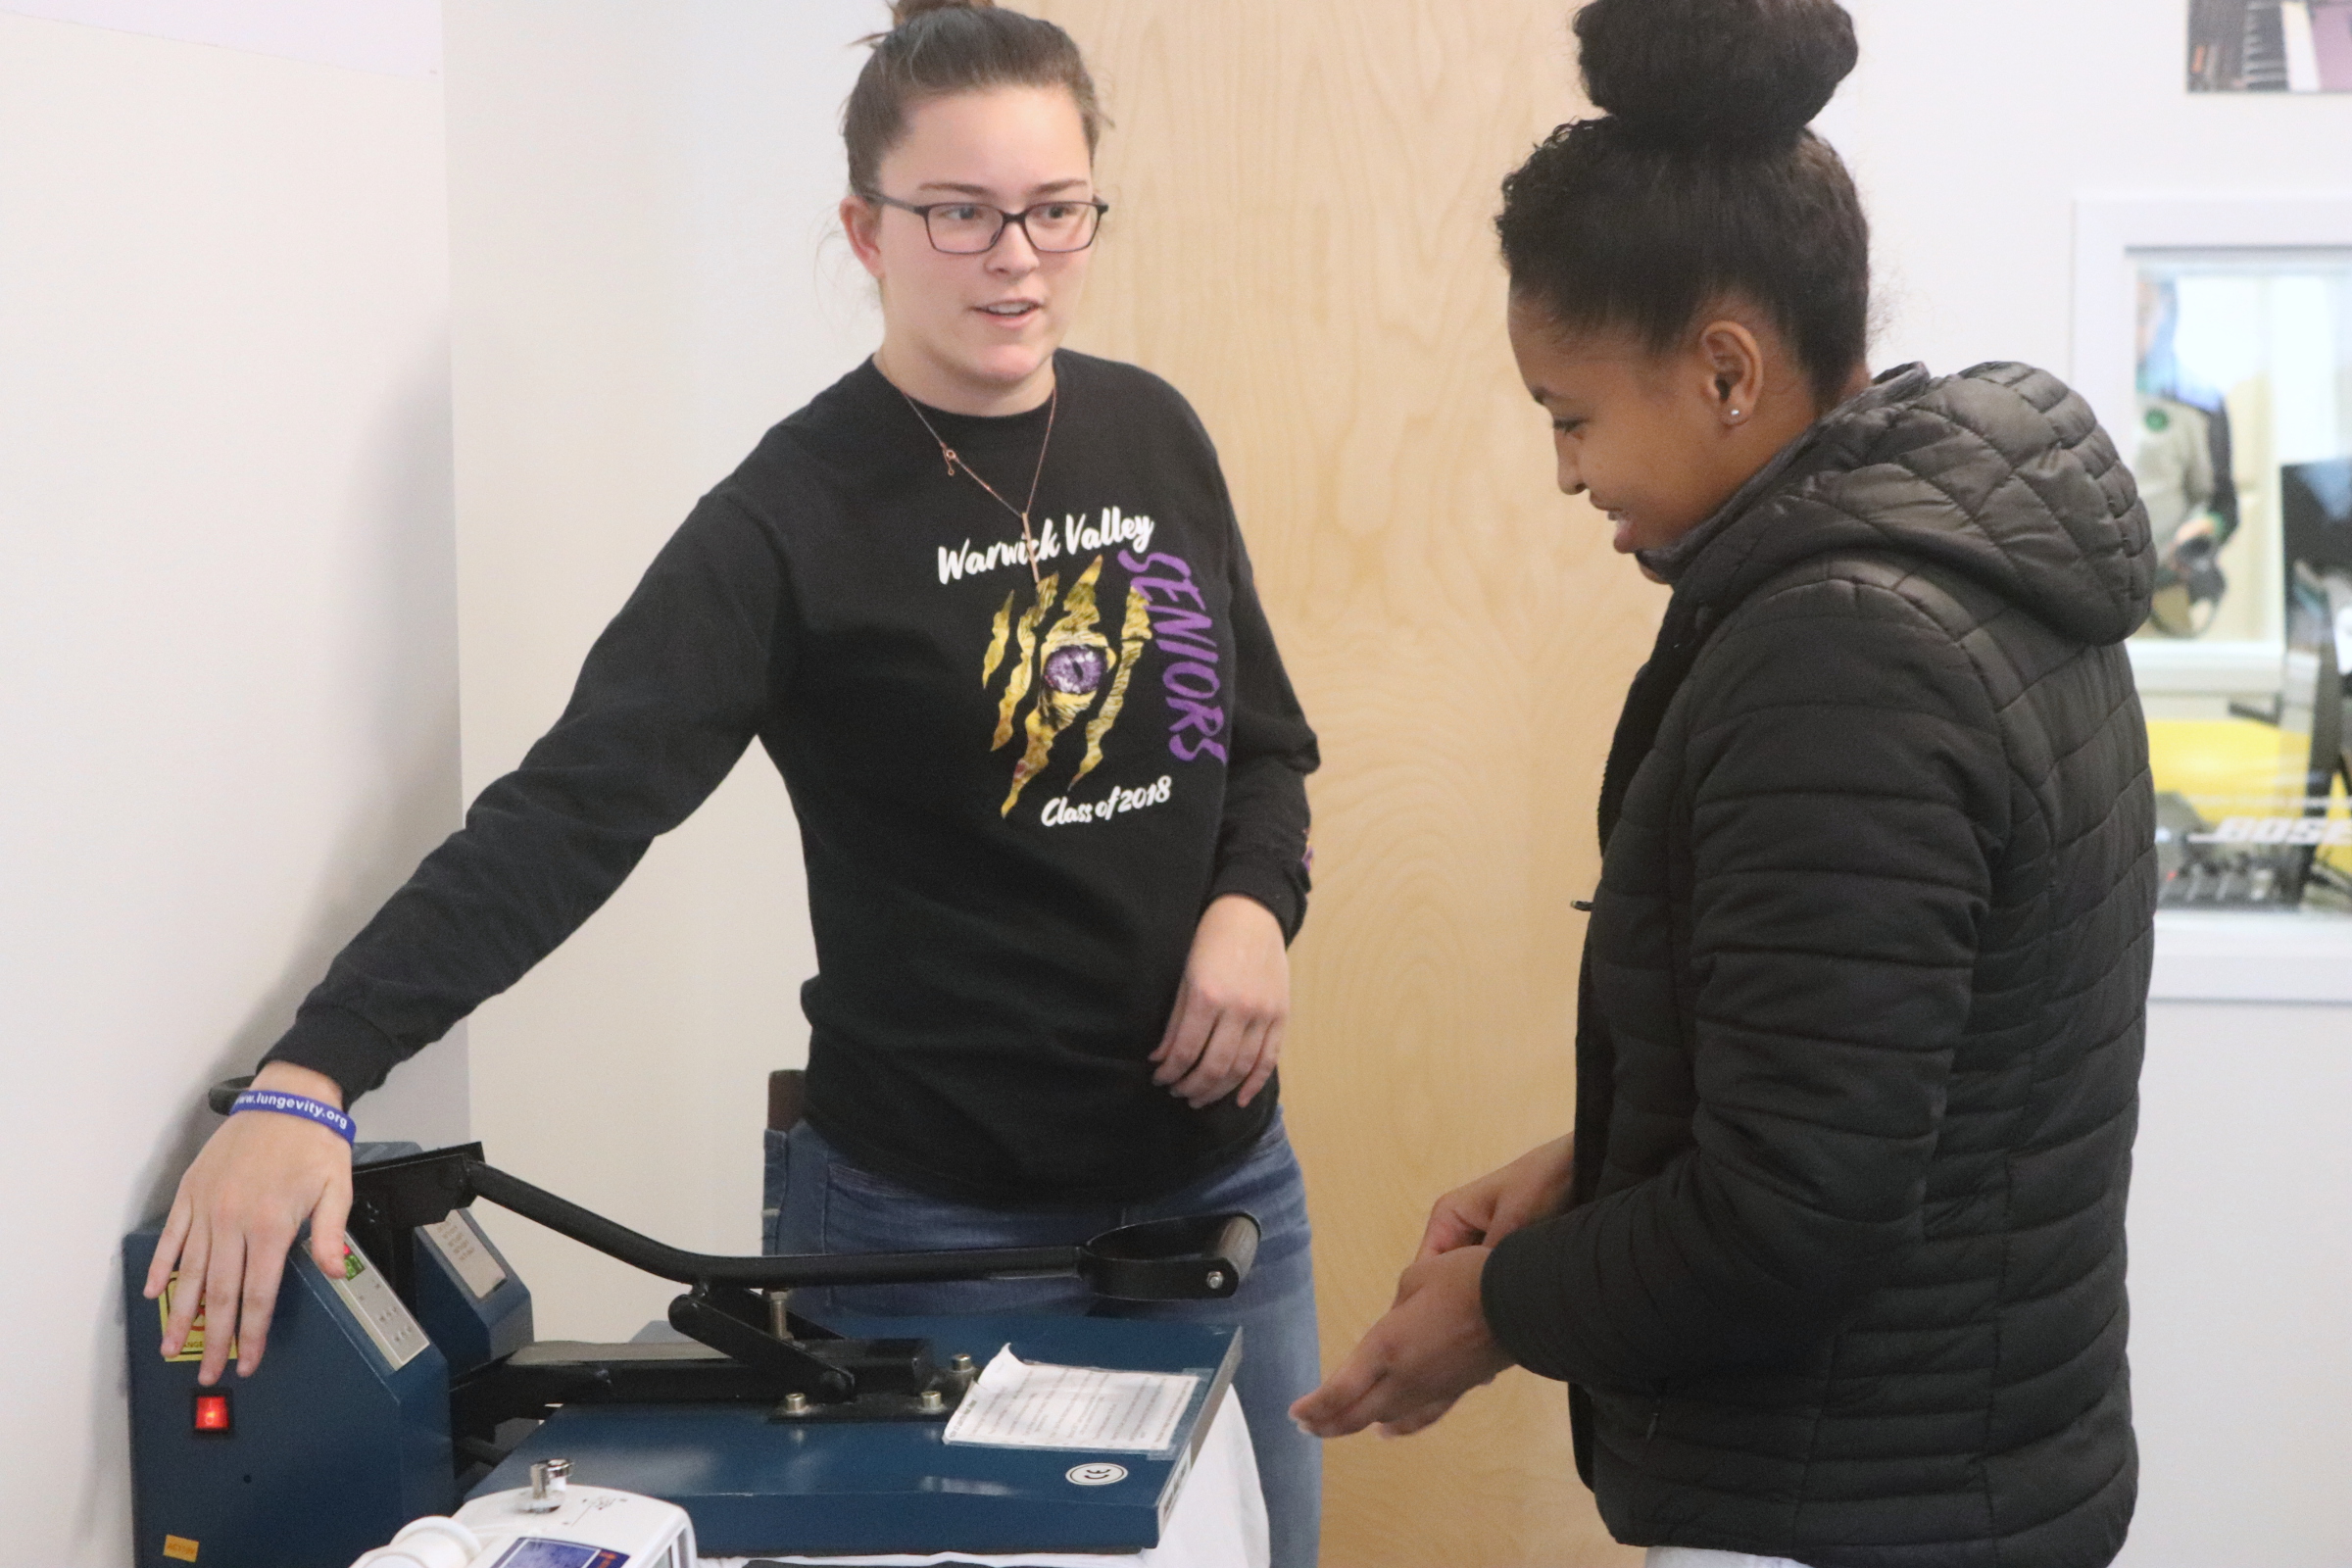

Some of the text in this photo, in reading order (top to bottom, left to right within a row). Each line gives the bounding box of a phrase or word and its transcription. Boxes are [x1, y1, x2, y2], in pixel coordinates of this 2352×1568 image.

[1064, 506, 1154, 555] Valley
[1117, 549, 1229, 766] SENIORS
[1041, 775, 1172, 827] Class of 2018
